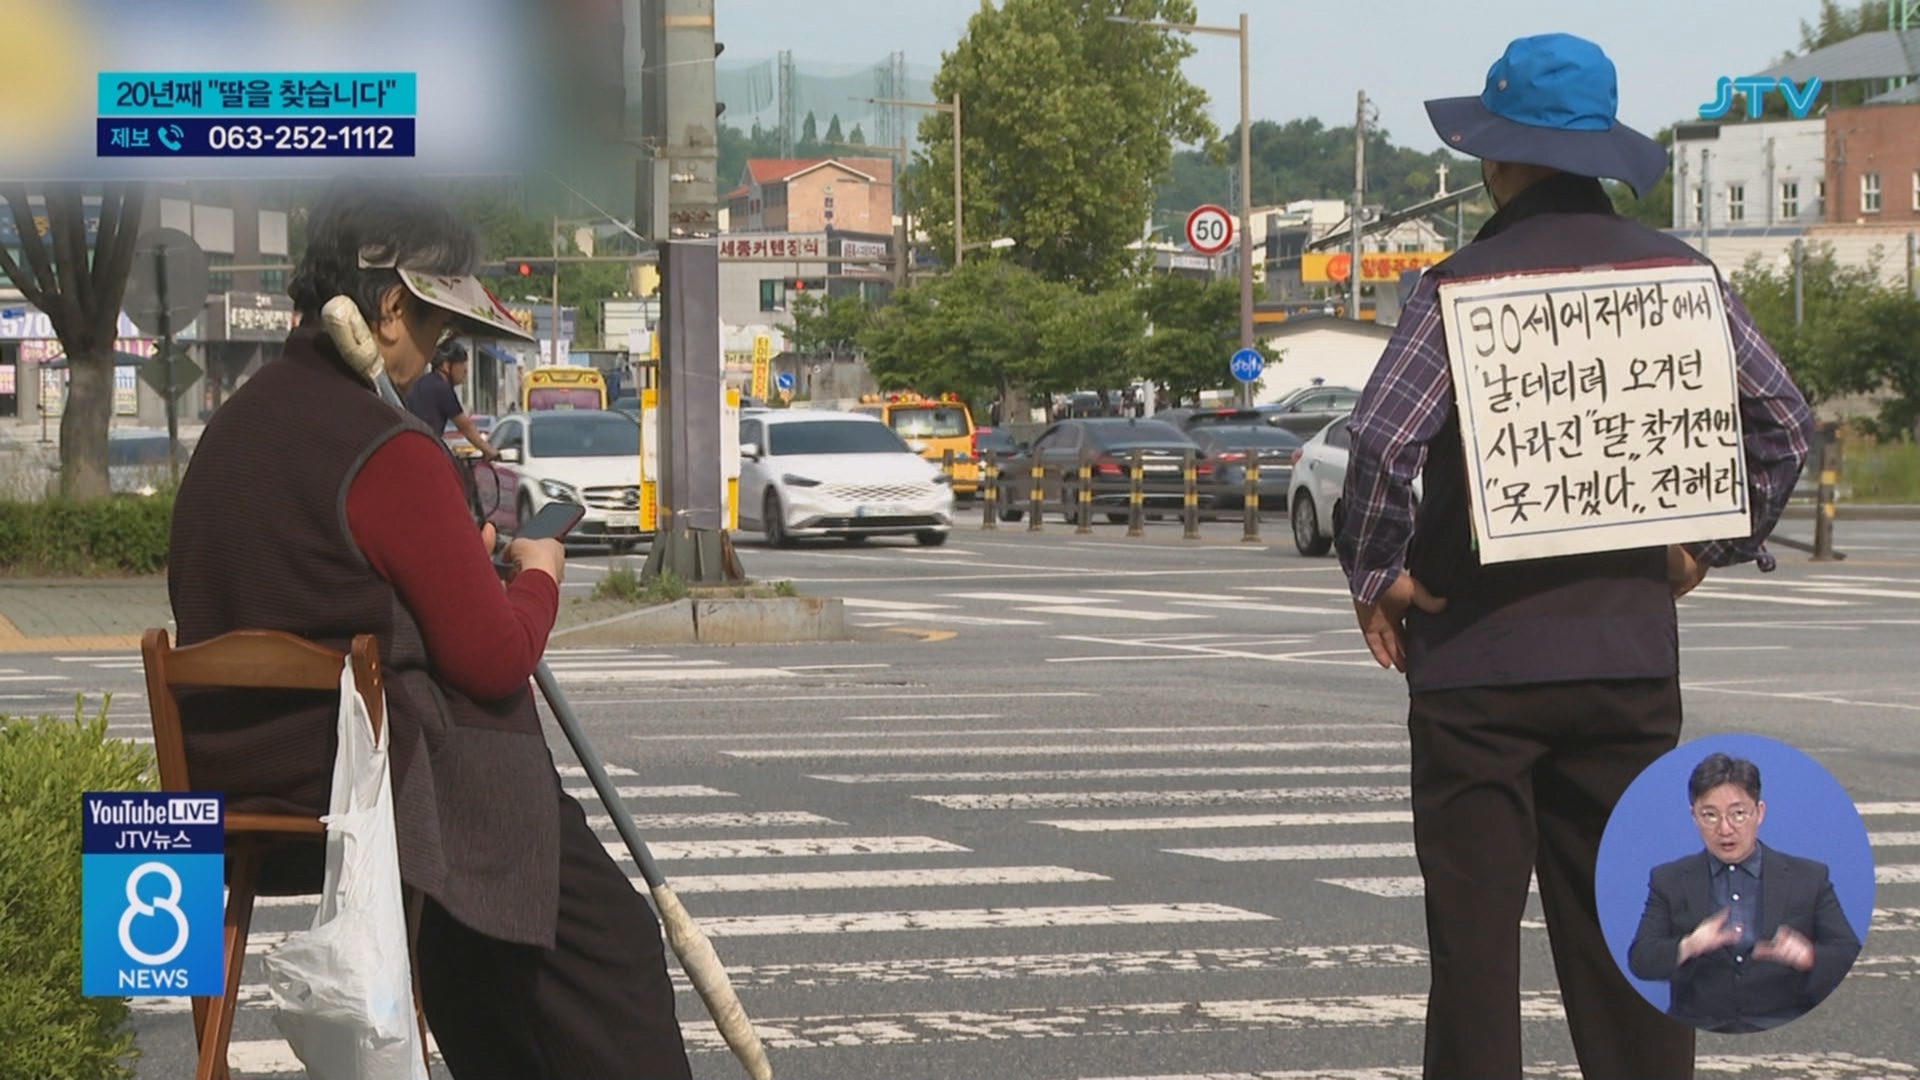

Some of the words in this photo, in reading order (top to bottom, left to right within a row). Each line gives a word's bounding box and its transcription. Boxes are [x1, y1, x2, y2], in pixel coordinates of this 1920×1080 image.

[720, 236, 819, 258] 세종커텐장식
[1195, 220, 1224, 241] 50
[1484, 414, 1583, 467] 사라진
[1650, 457, 1744, 508] 전해라
